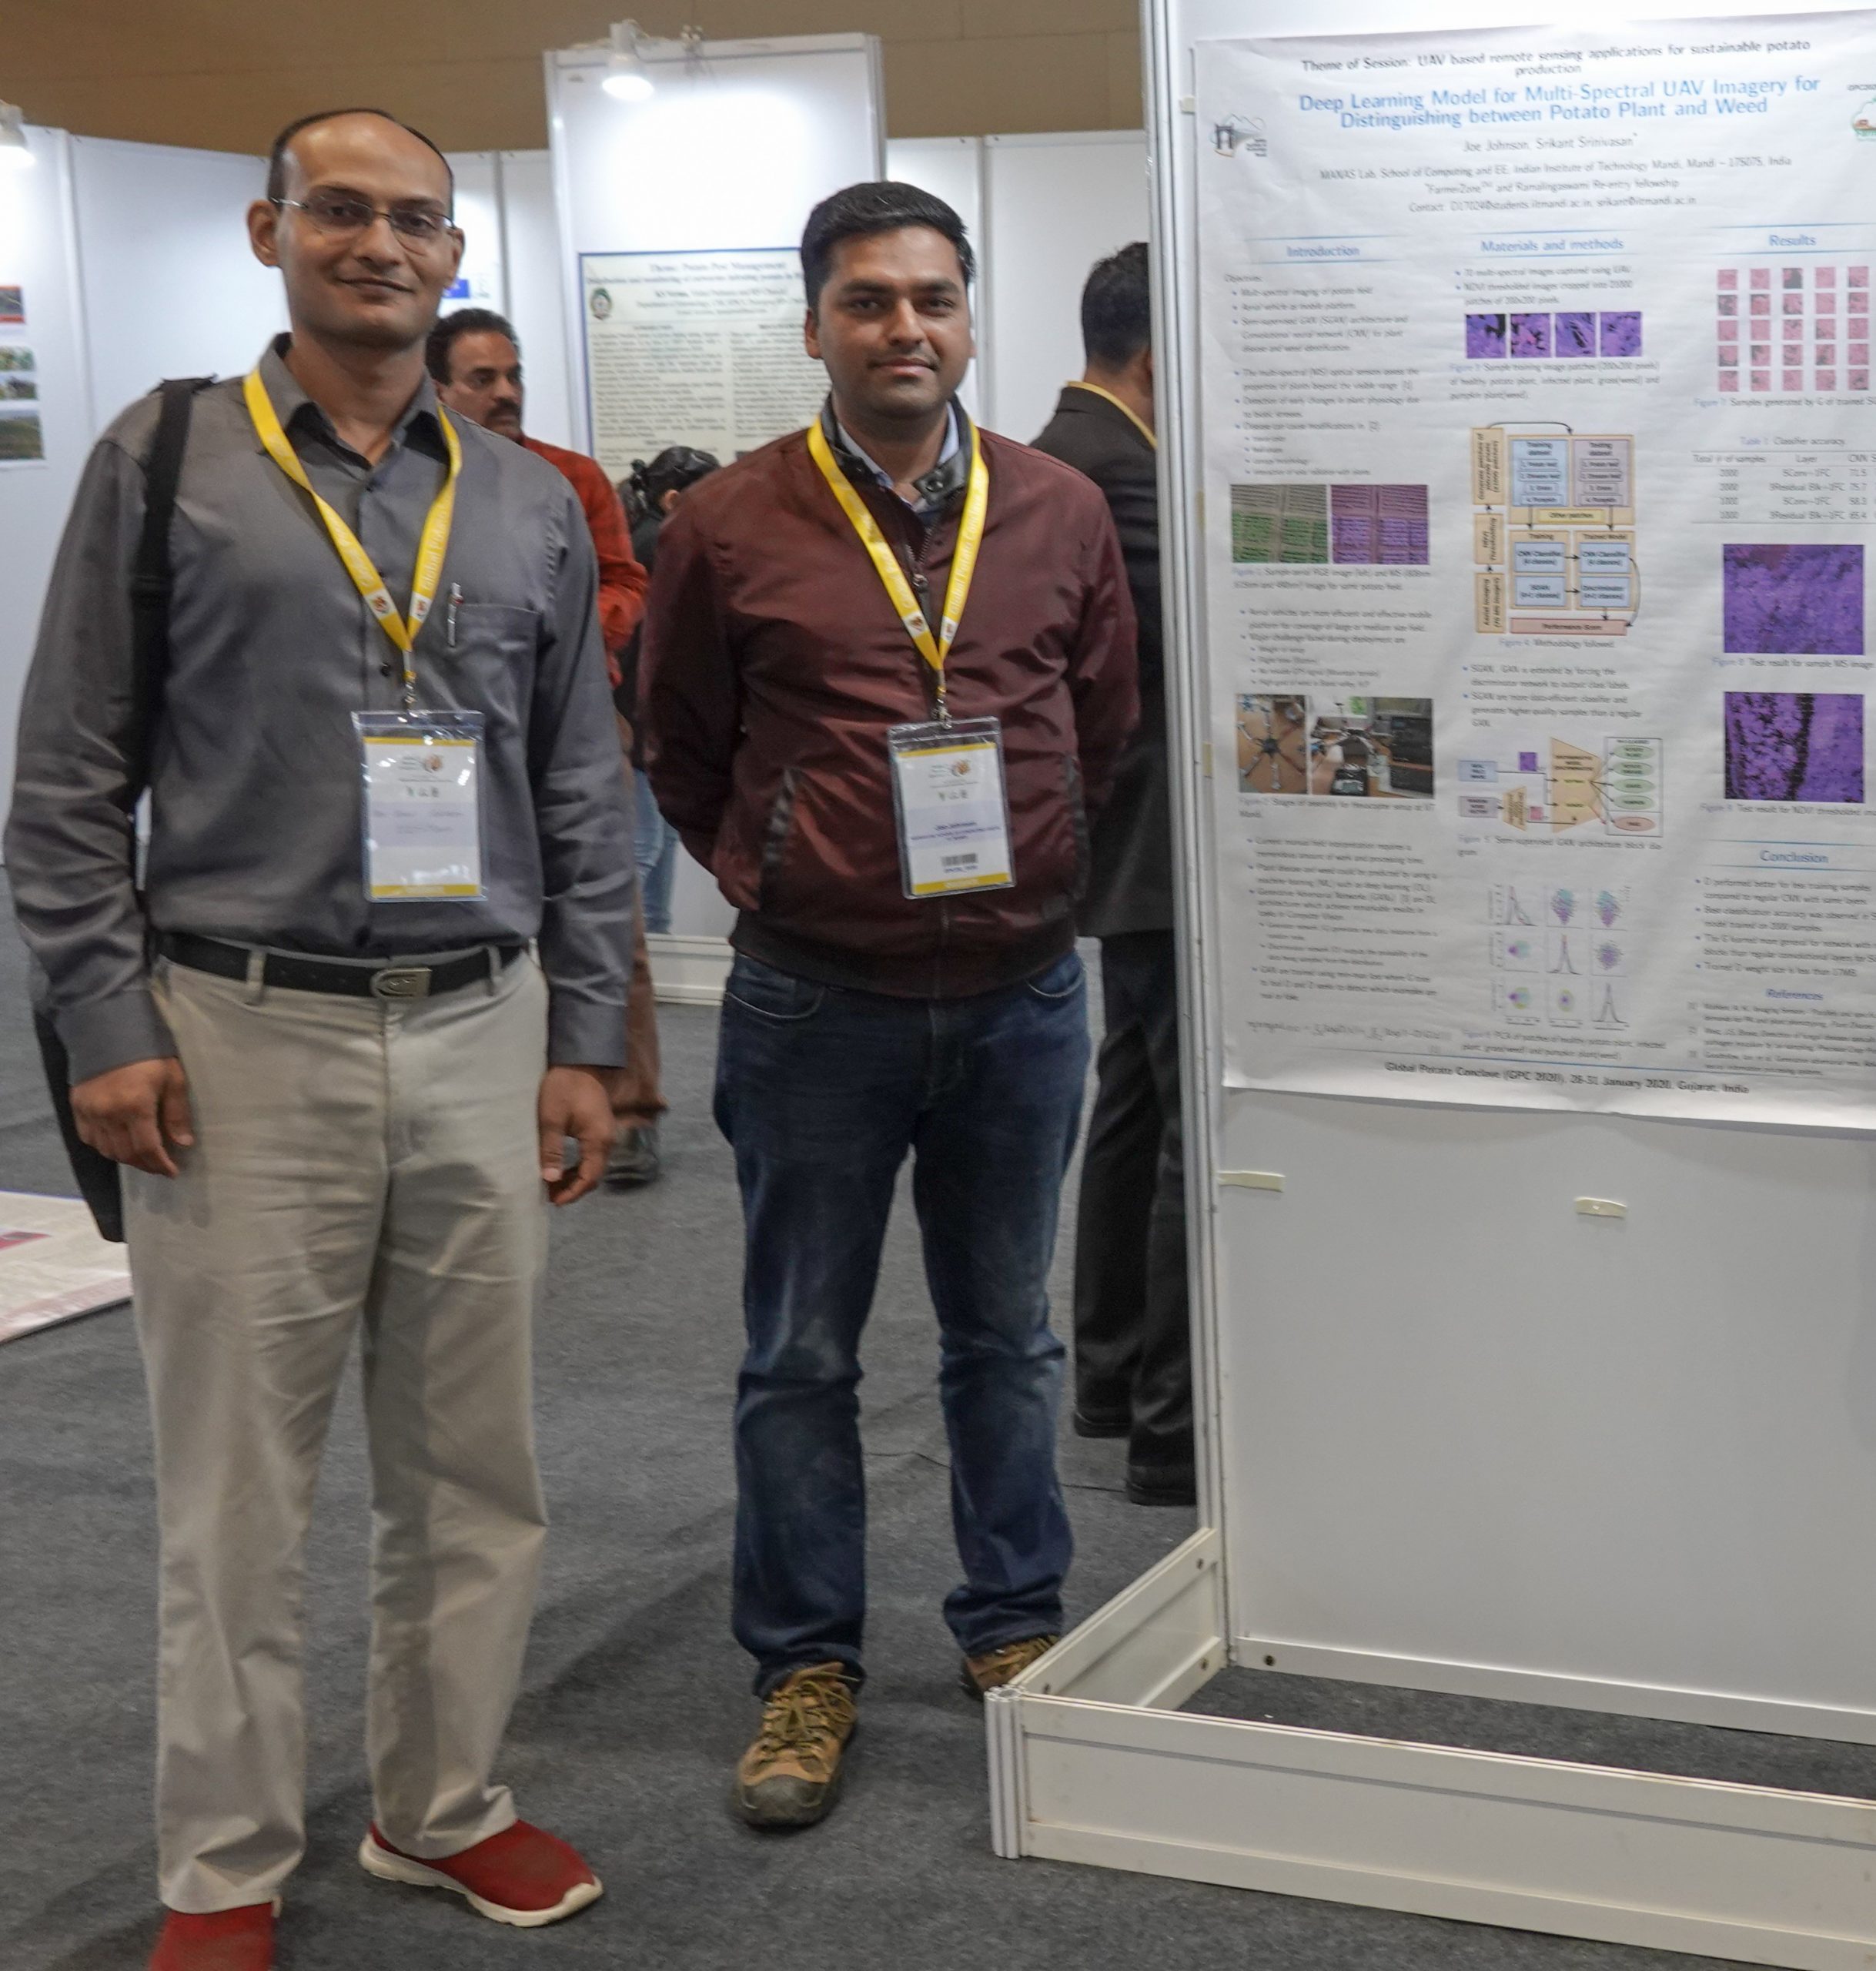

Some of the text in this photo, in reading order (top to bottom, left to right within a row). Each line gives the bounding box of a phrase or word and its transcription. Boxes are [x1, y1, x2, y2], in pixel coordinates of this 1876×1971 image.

[1302, 39, 1811, 72] Theme of Session: UAV based remote sensing applications for sustainable potato
[1515, 63, 1581, 78] production
[1299, 75, 1820, 113] Deep Learning Model for Multi-Spectral UAV Imagery for
[1340, 97, 1767, 131] Distinguishing between Potato Plant and Weed
[1463, 140, 1483, 152] Joe
[1536, 136, 1573, 149] Srikant
[1320, 169, 1356, 180] MANAS
[1381, 166, 1408, 178] School
[1411, 166, 1422, 177] of
[1424, 166, 1473, 179] Computing
[1476, 164, 1492, 175] and
[1513, 162, 1540, 174] Indian
[1543, 161, 1581, 173] Institute
[1584, 160, 1594, 172] of
[1597, 159, 1649, 173] Technology
[1768, 156, 1792, 166] India
[1480, 238, 1624, 253] Materials and methods
[1769, 235, 1817, 246] Results
[1286, 245, 1360, 258] Introduction
[1760, 850, 1829, 865] Conclusion
[1766, 988, 1824, 1002] References
[1385, 1061, 1417, 1073] Global
[1420, 1063, 1453, 1076] Potato
[1456, 1066, 1502, 1079] Conclave
[1503, 1069, 1532, 1082] (GPC
[1603, 1074, 1642, 1089] January
[1721, 1081, 1749, 1094] India
